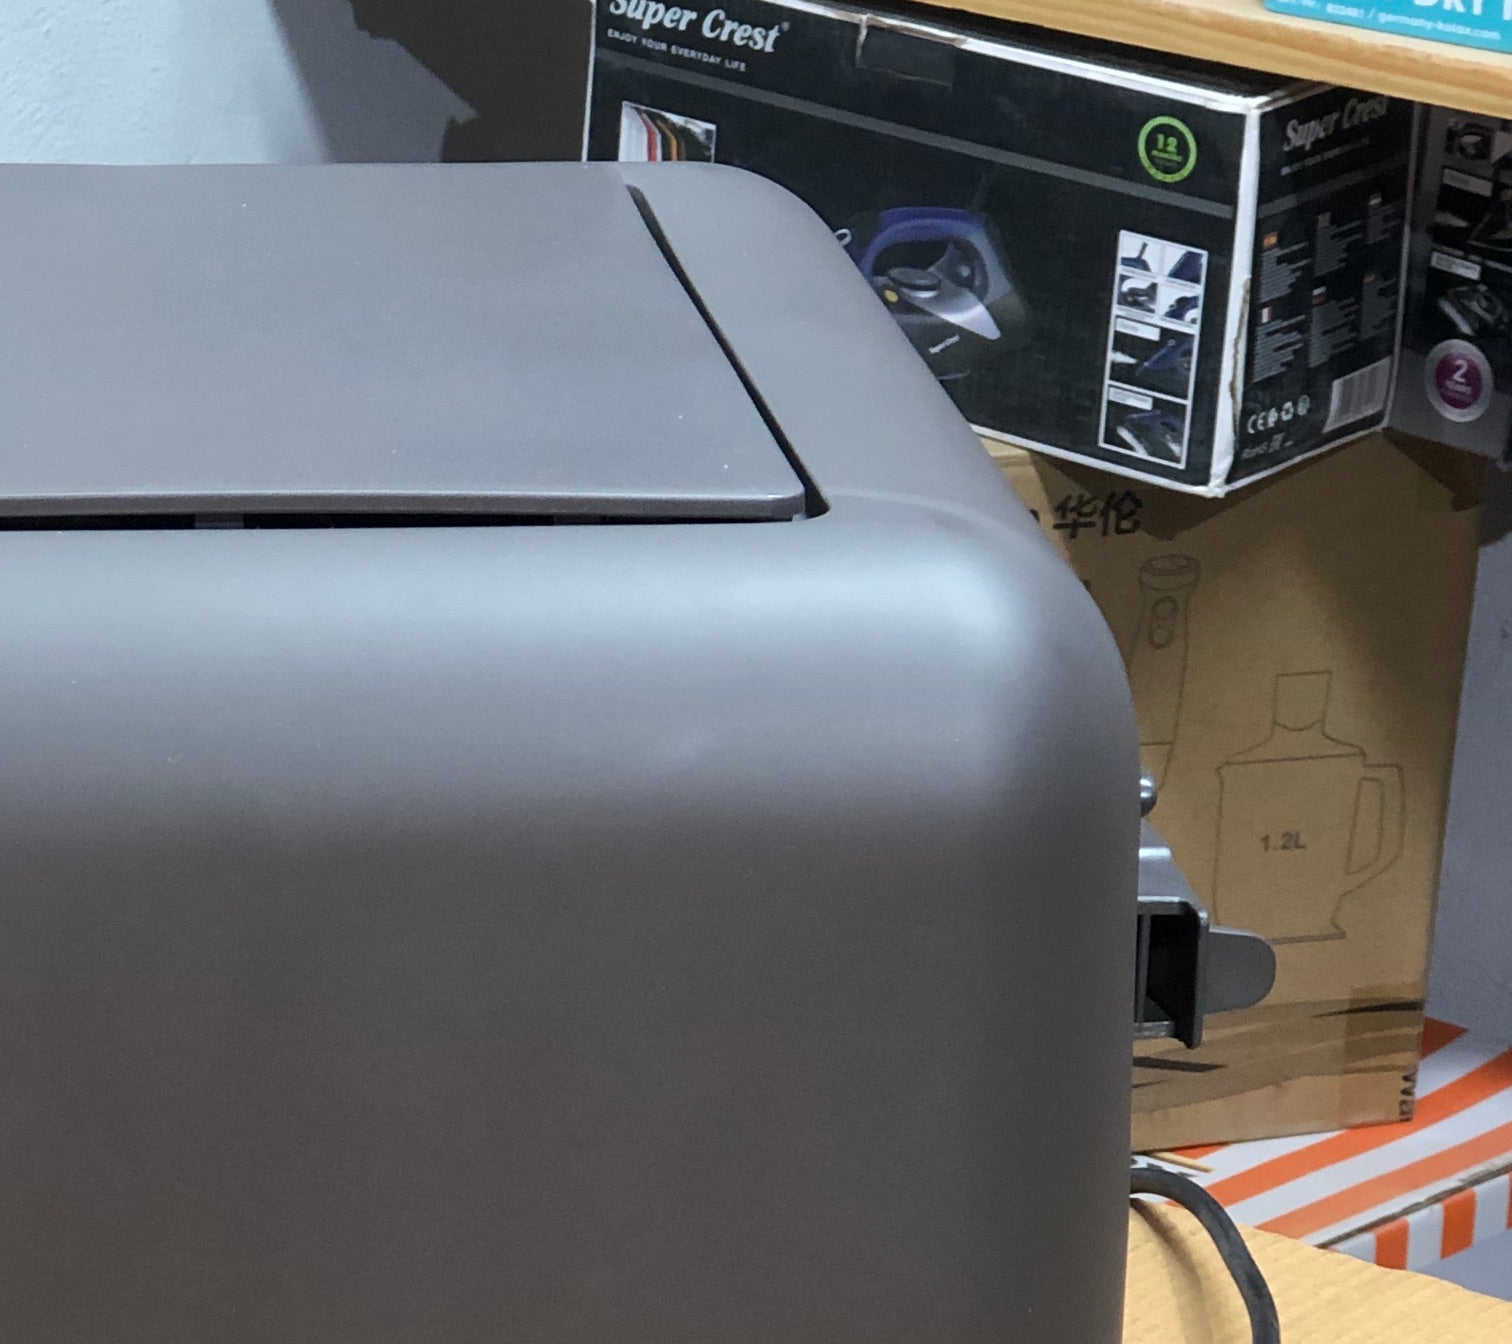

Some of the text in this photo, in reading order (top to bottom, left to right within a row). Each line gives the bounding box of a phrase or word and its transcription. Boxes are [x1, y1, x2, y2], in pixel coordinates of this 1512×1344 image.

[702, 9, 781, 52] Crest
[607, 28, 746, 72] ENJOY YOUR EVERYDAY LIFE
[1452, 359, 1468, 383] 2
[1259, 831, 1307, 853] 1.2L
